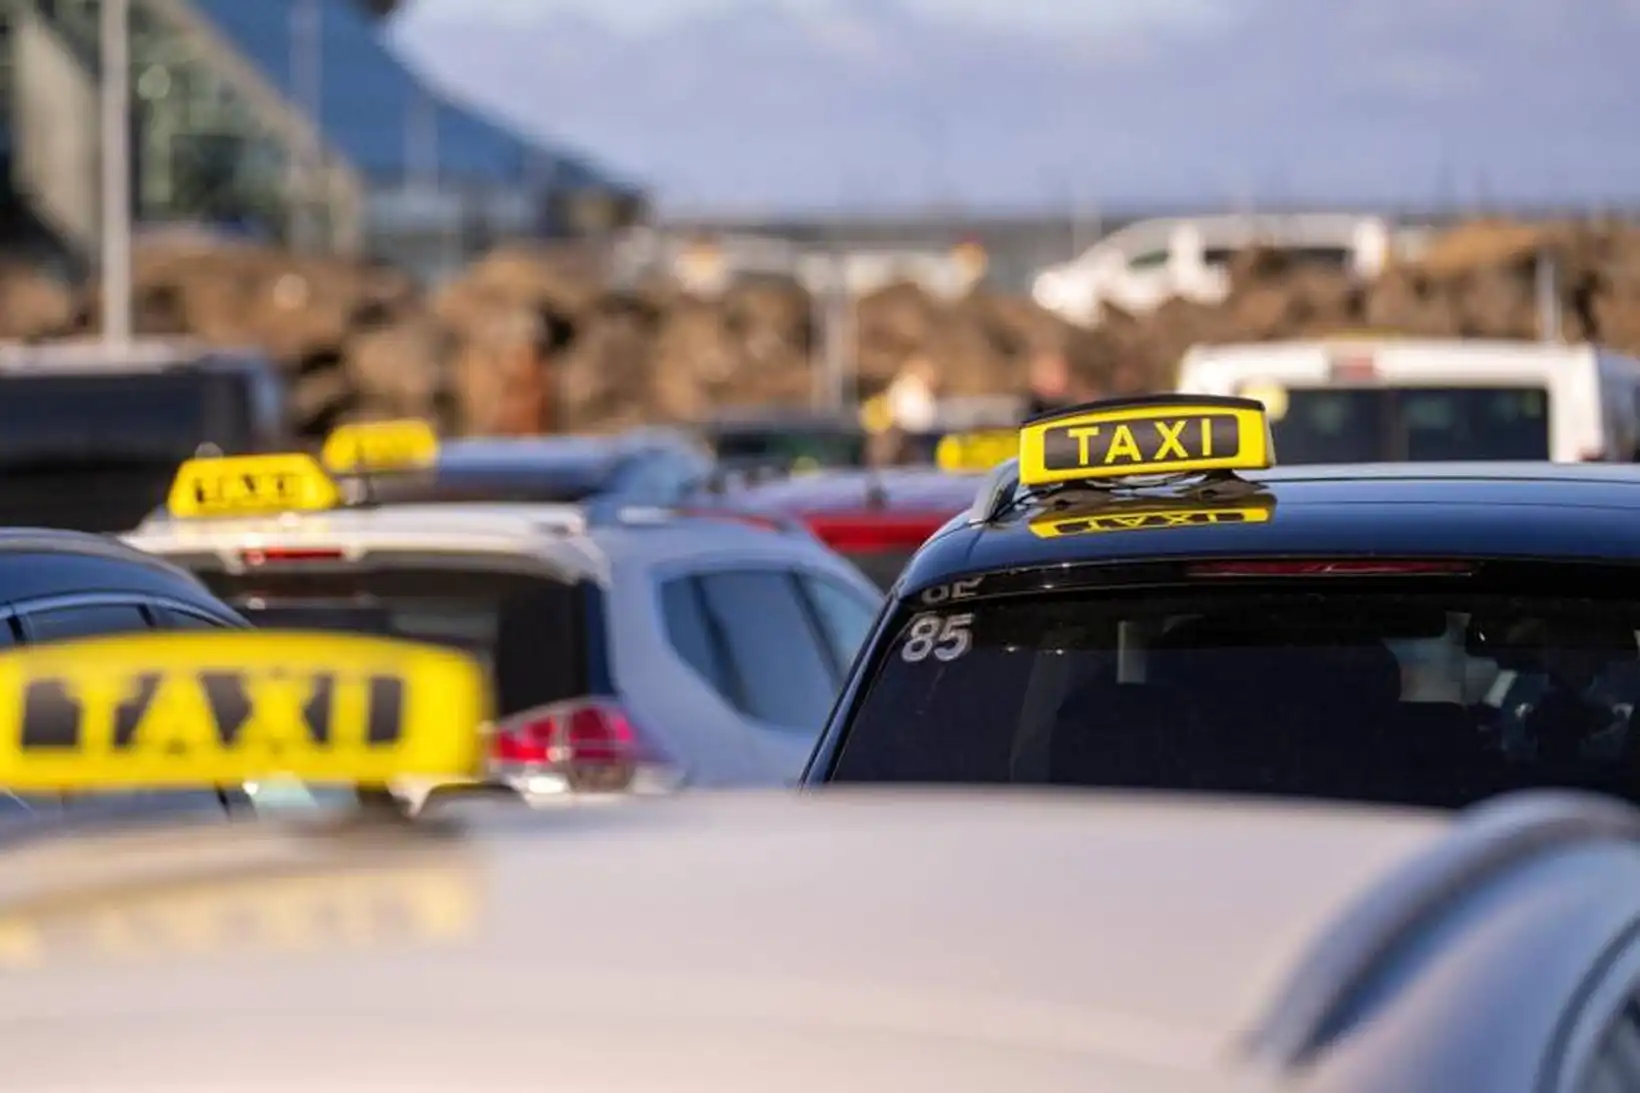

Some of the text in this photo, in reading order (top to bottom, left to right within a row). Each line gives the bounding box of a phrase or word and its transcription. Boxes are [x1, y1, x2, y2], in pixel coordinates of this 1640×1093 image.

[1068, 417, 1213, 466] TAXI
[901, 612, 975, 662] 85
[63, 672, 368, 750] TAXI
